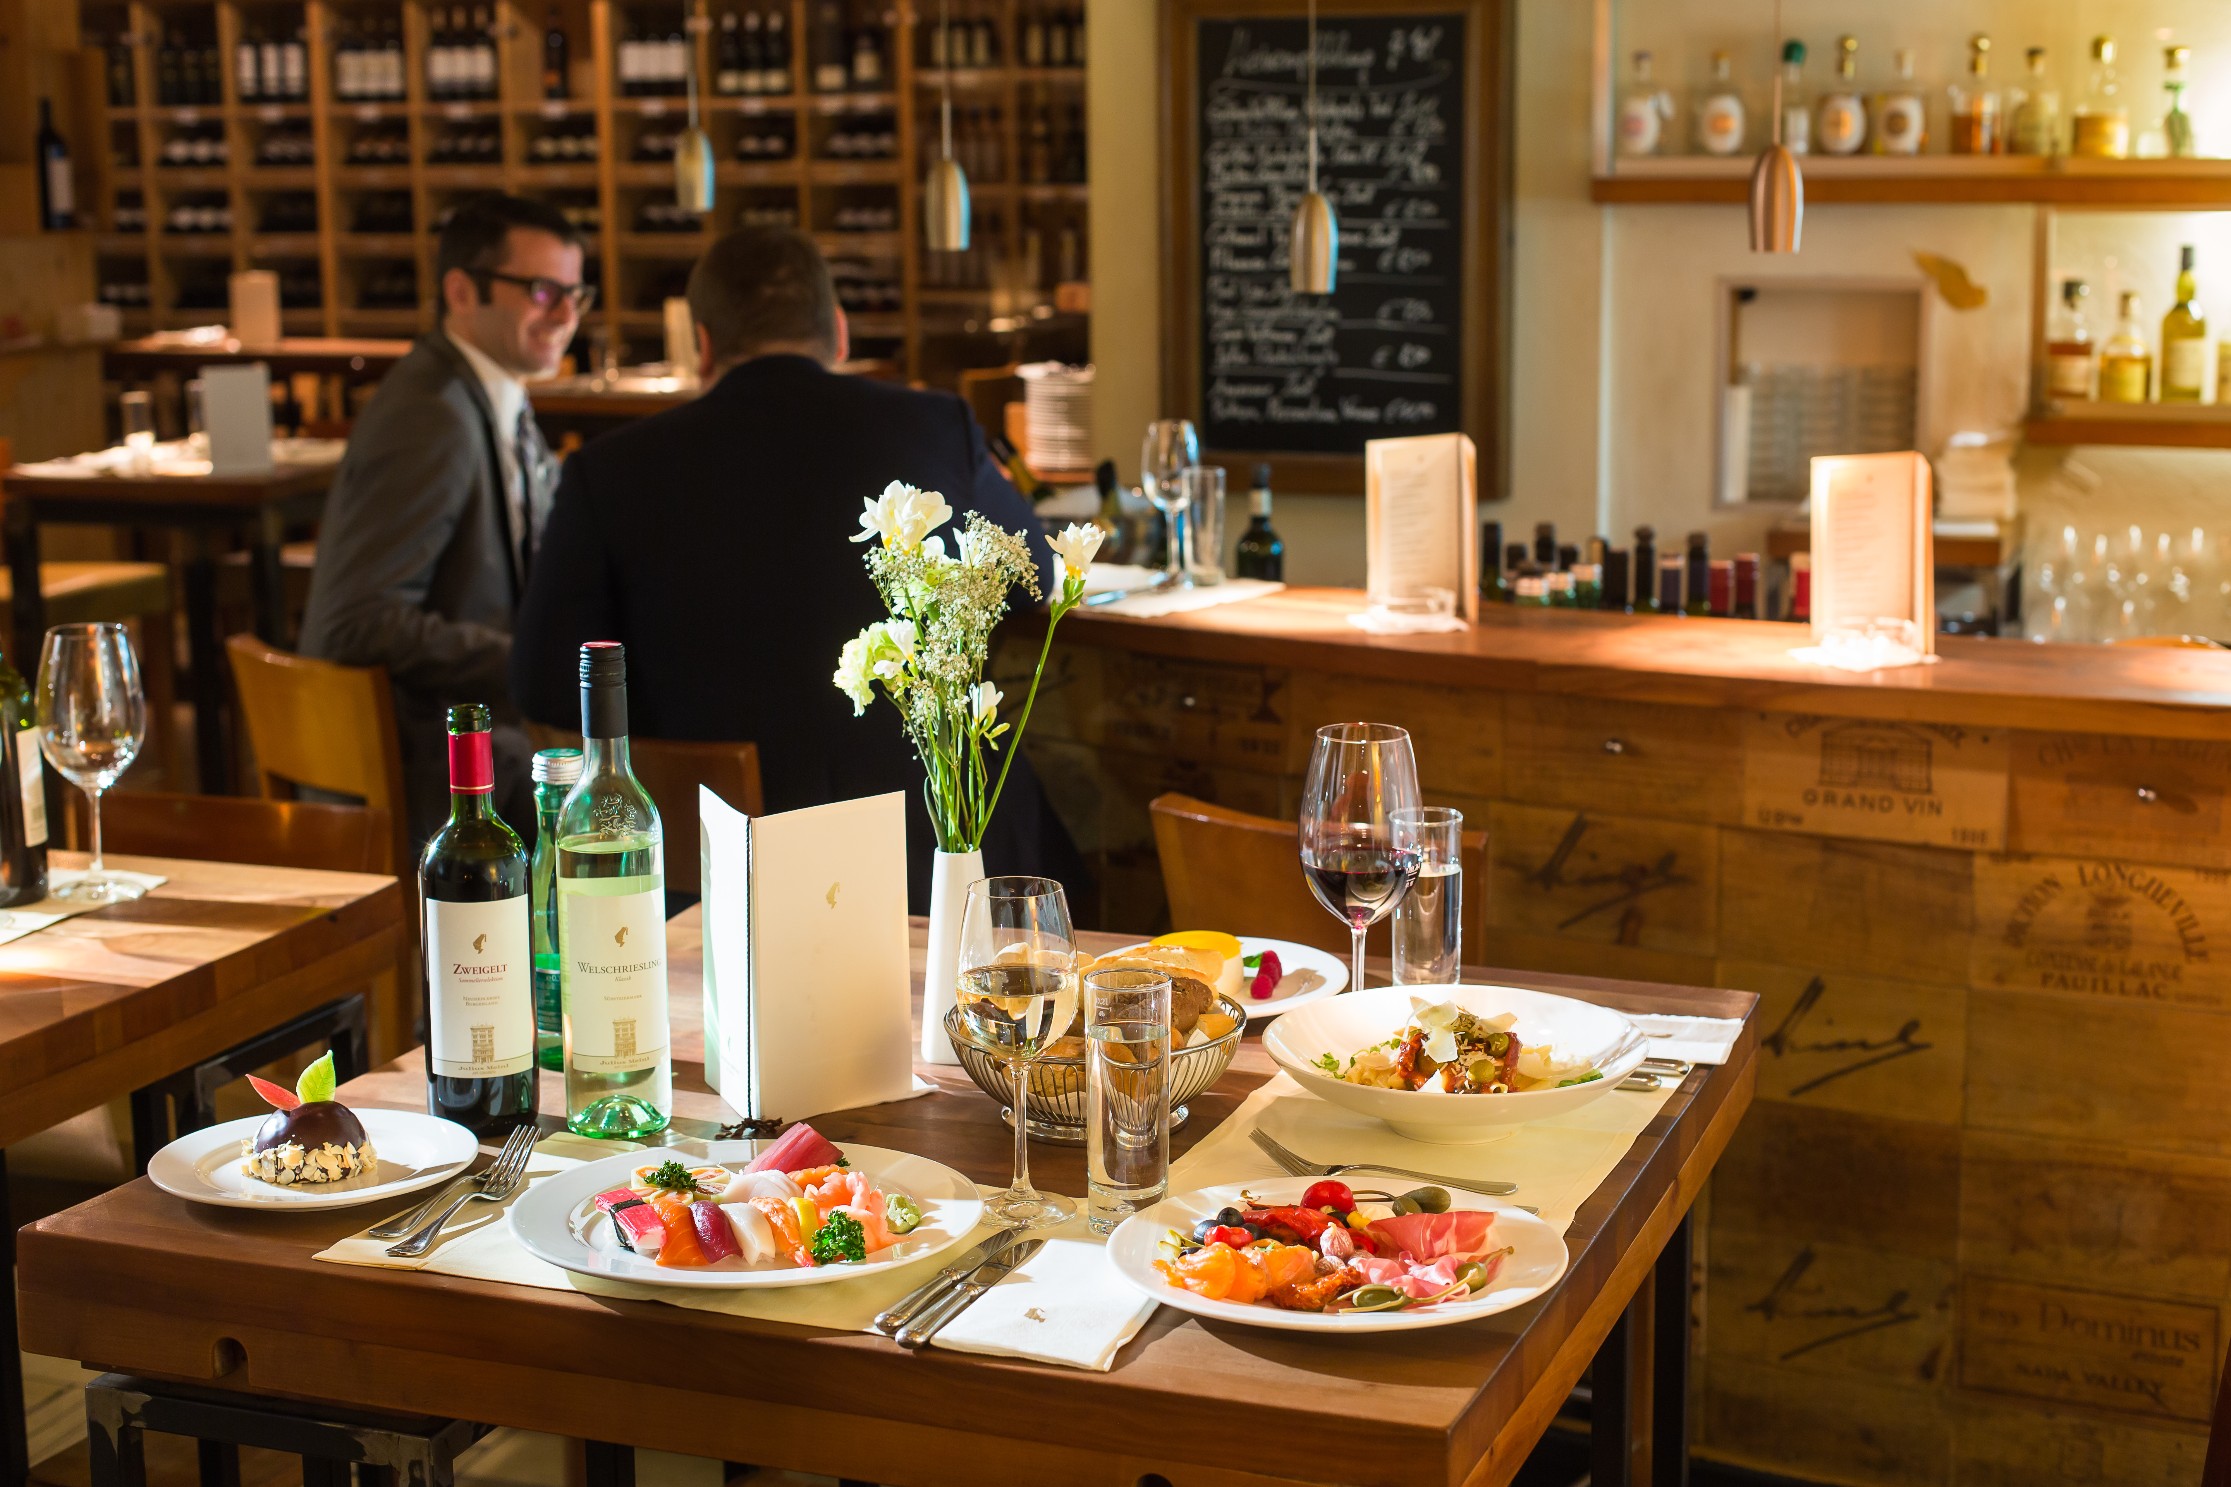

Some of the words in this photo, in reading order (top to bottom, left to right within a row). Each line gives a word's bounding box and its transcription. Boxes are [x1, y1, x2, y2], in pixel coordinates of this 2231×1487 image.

[1802, 787, 1895, 814] GRAND
[1902, 797, 1943, 817] VIN
[453, 963, 508, 975] ZWEIGELT
[577, 958, 661, 975] WELSCHRIESLING
